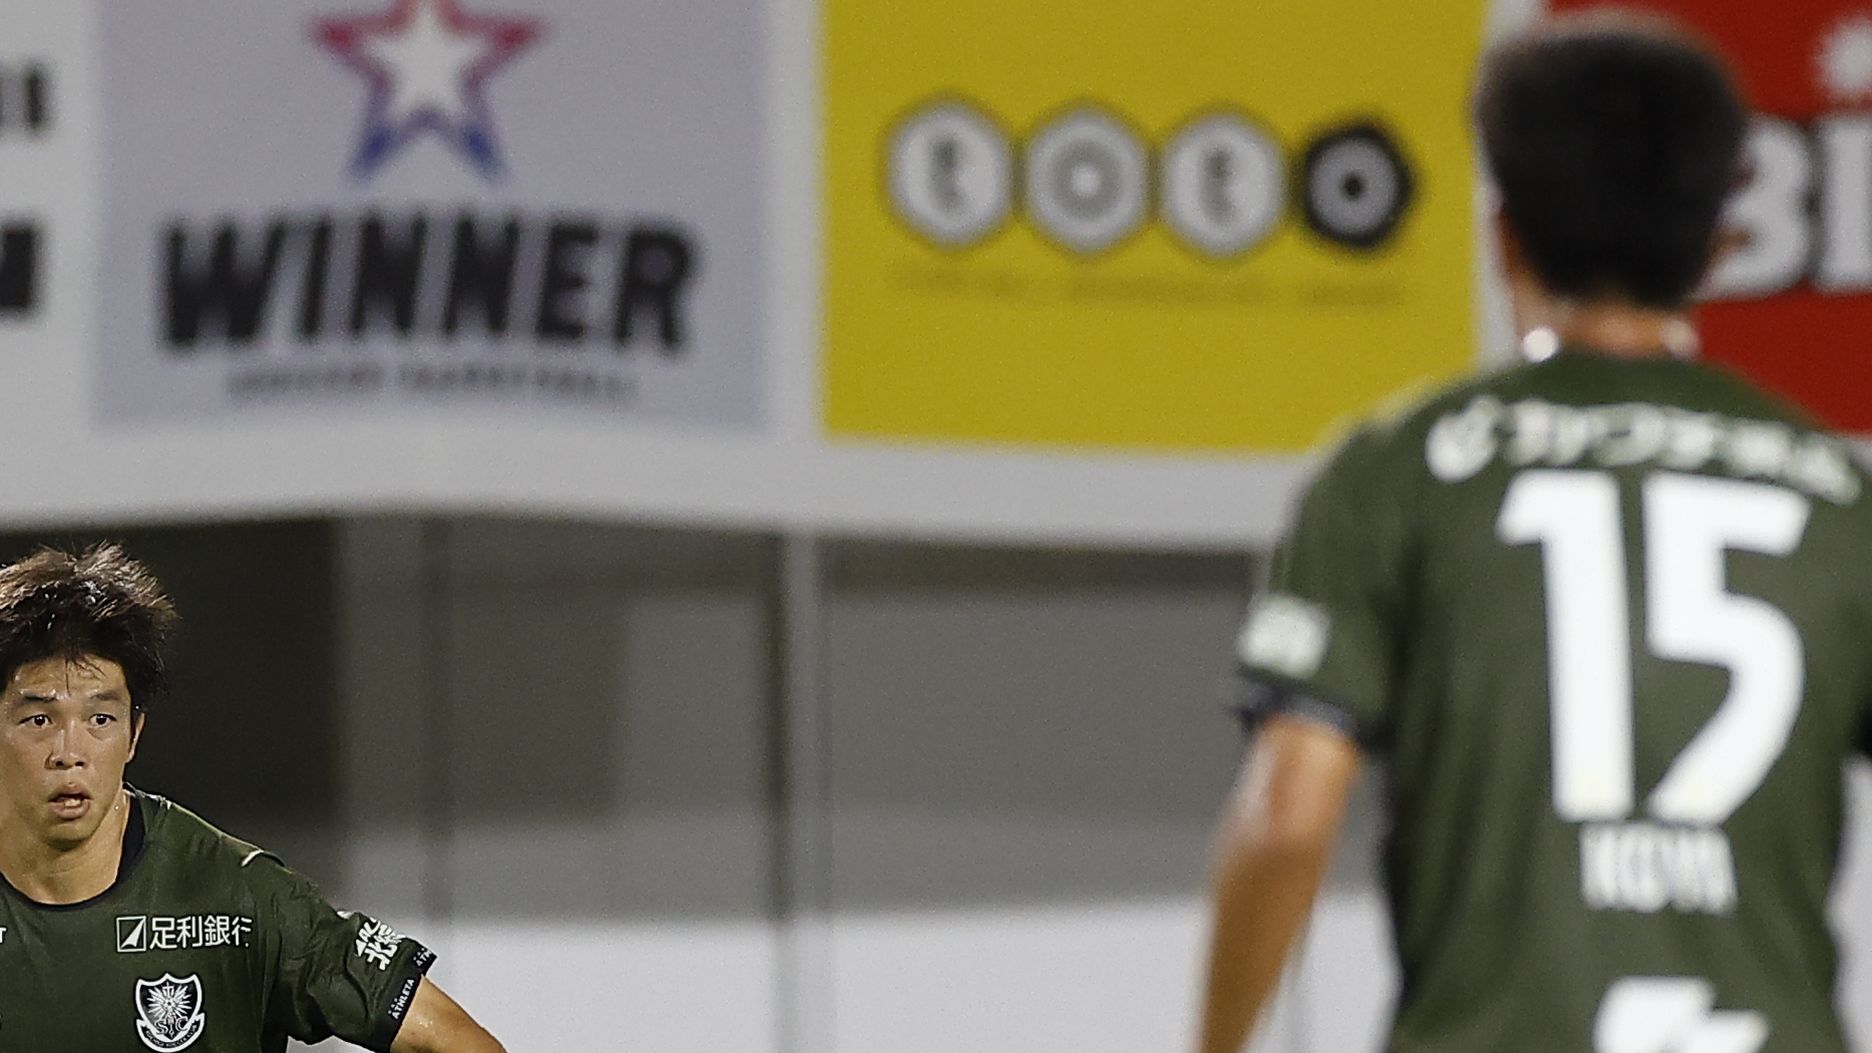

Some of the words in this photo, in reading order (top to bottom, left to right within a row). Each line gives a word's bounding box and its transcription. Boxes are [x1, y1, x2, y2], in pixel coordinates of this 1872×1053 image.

[896, 105, 1410, 256] toto
[156, 206, 702, 356] WINNER
[1495, 468, 1812, 827] 15
[150, 915, 253, 950] 足利銀行
